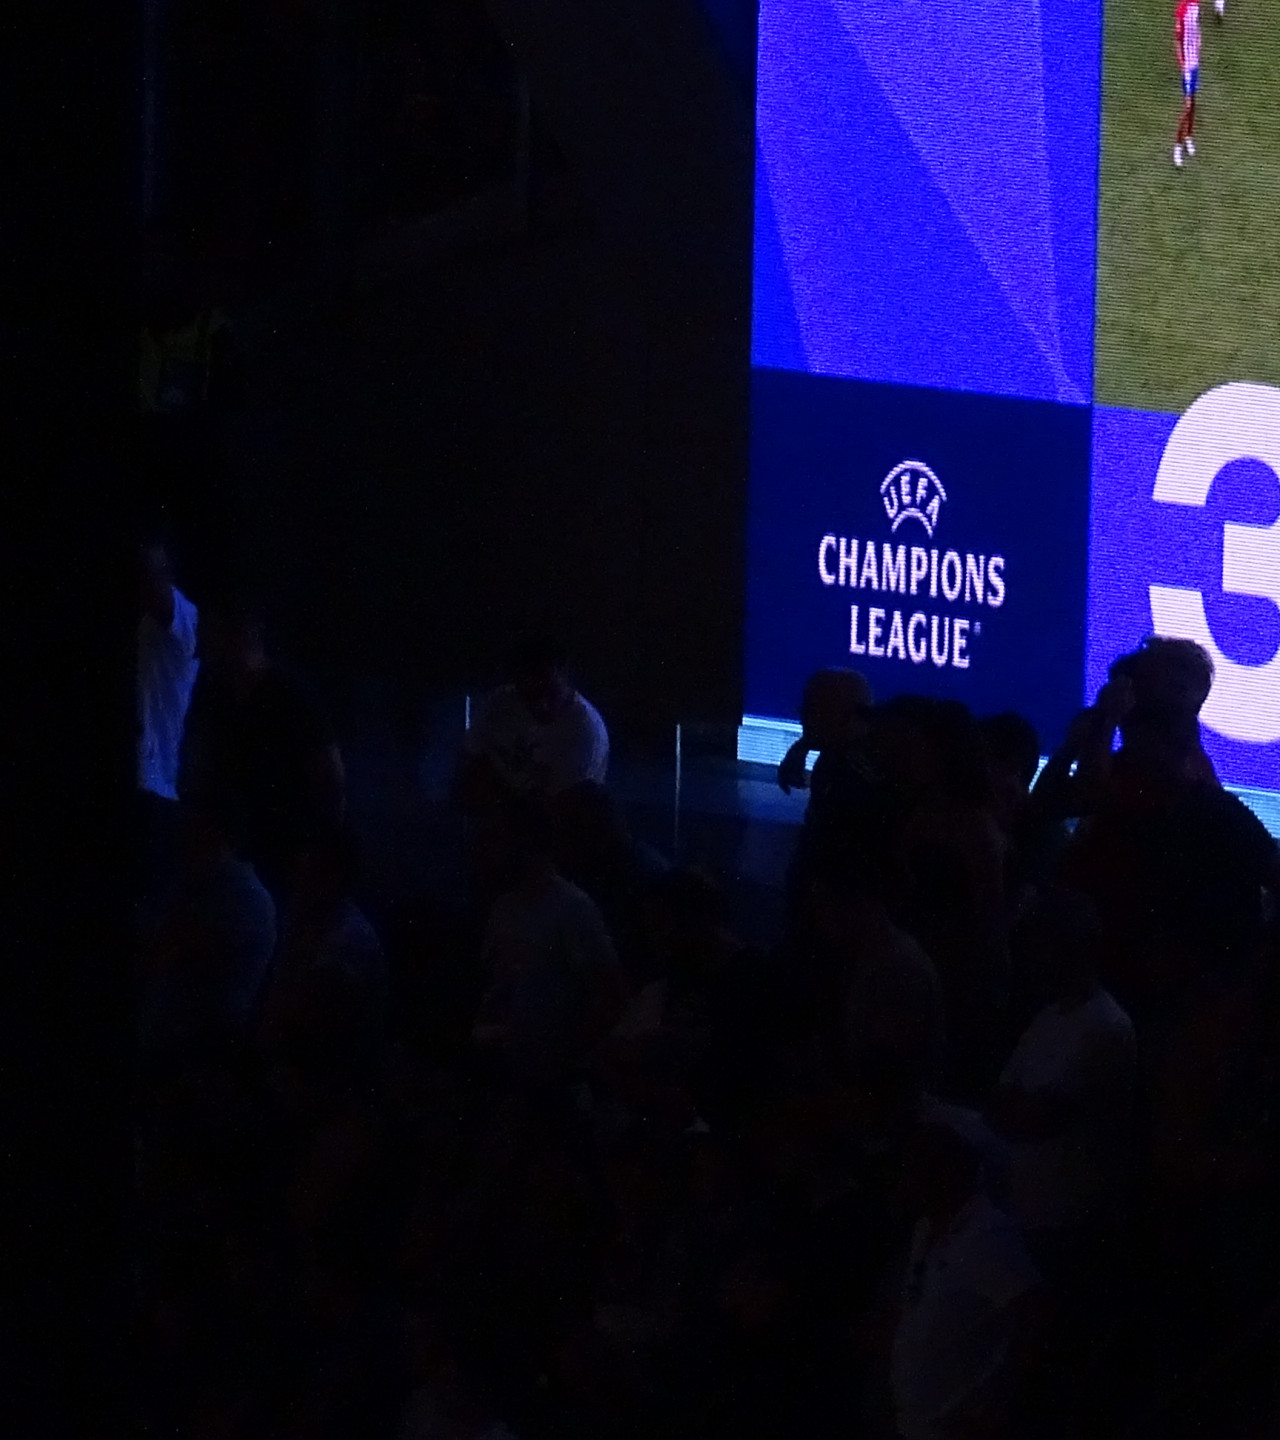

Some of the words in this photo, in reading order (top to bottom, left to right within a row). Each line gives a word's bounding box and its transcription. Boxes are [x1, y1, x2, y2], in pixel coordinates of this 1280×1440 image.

[882, 471, 941, 528] UEFA
[817, 533, 1006, 607] CHAMPIONS
[850, 604, 971, 669] LEAGUE
